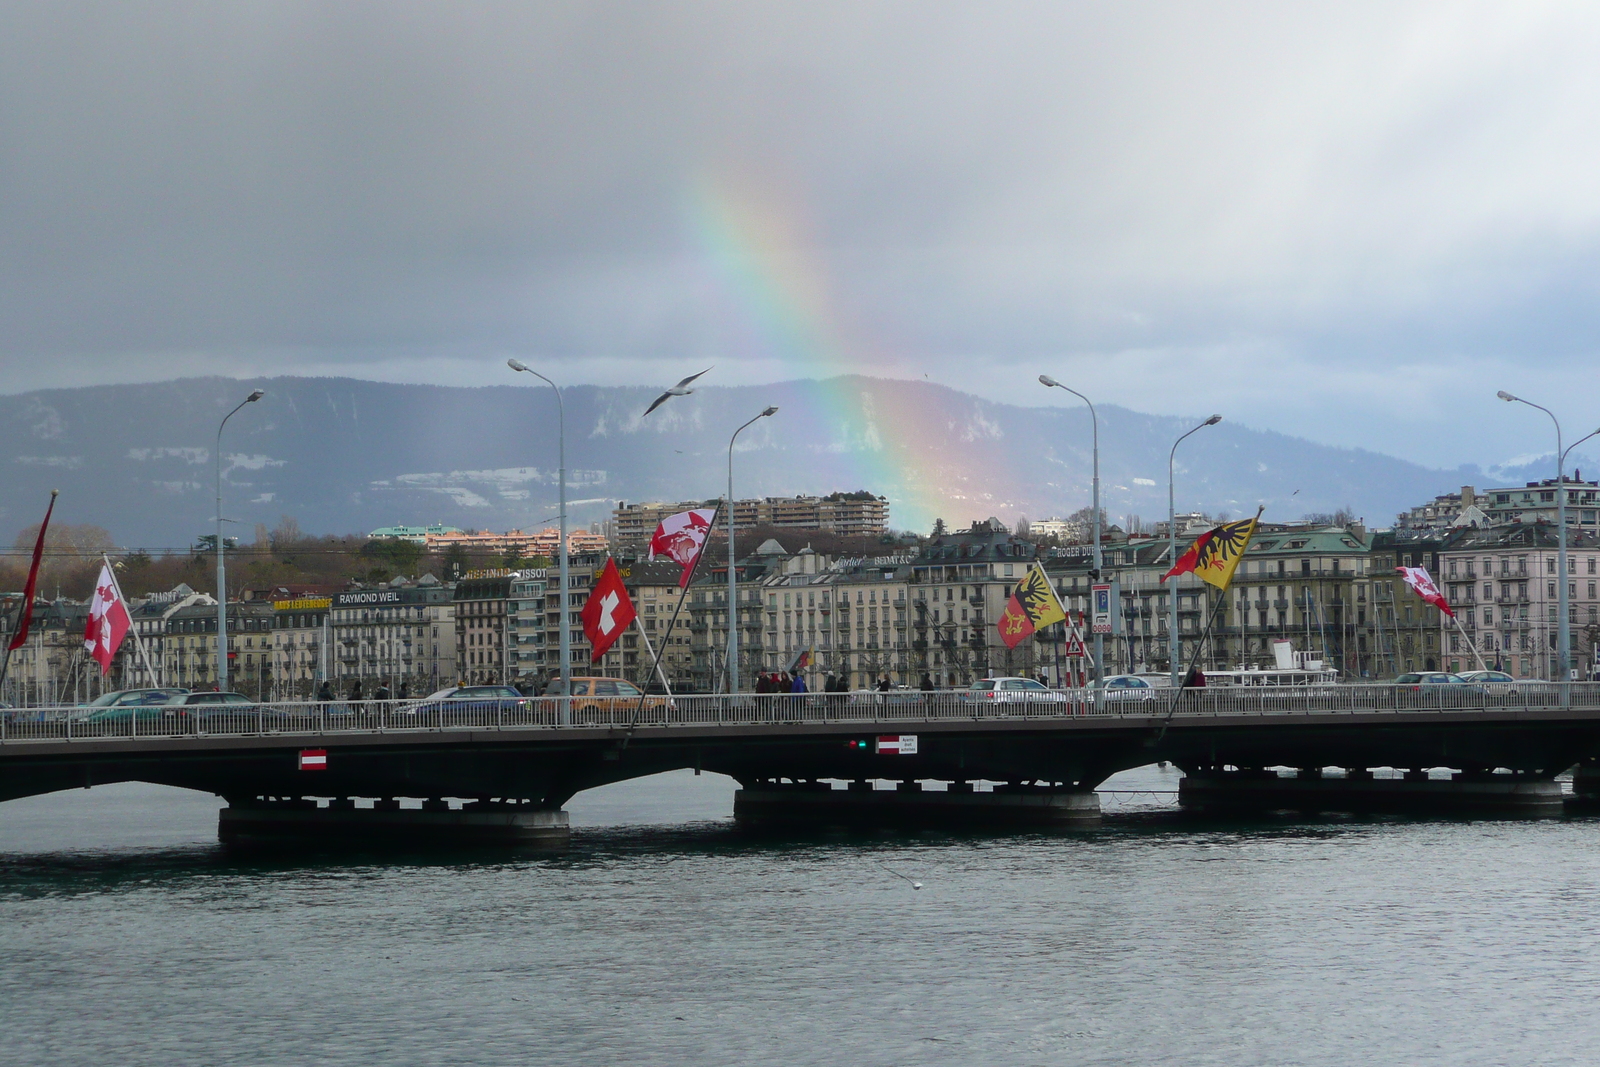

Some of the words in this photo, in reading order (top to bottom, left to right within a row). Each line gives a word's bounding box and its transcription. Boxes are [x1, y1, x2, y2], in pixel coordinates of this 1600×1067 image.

[1057, 547, 1080, 558] ROGER
[838, 555, 864, 568] Cartier
[517, 568, 547, 579] TISSOT
[339, 593, 377, 604] RAYMOND
[379, 592, 400, 602] WEIL
